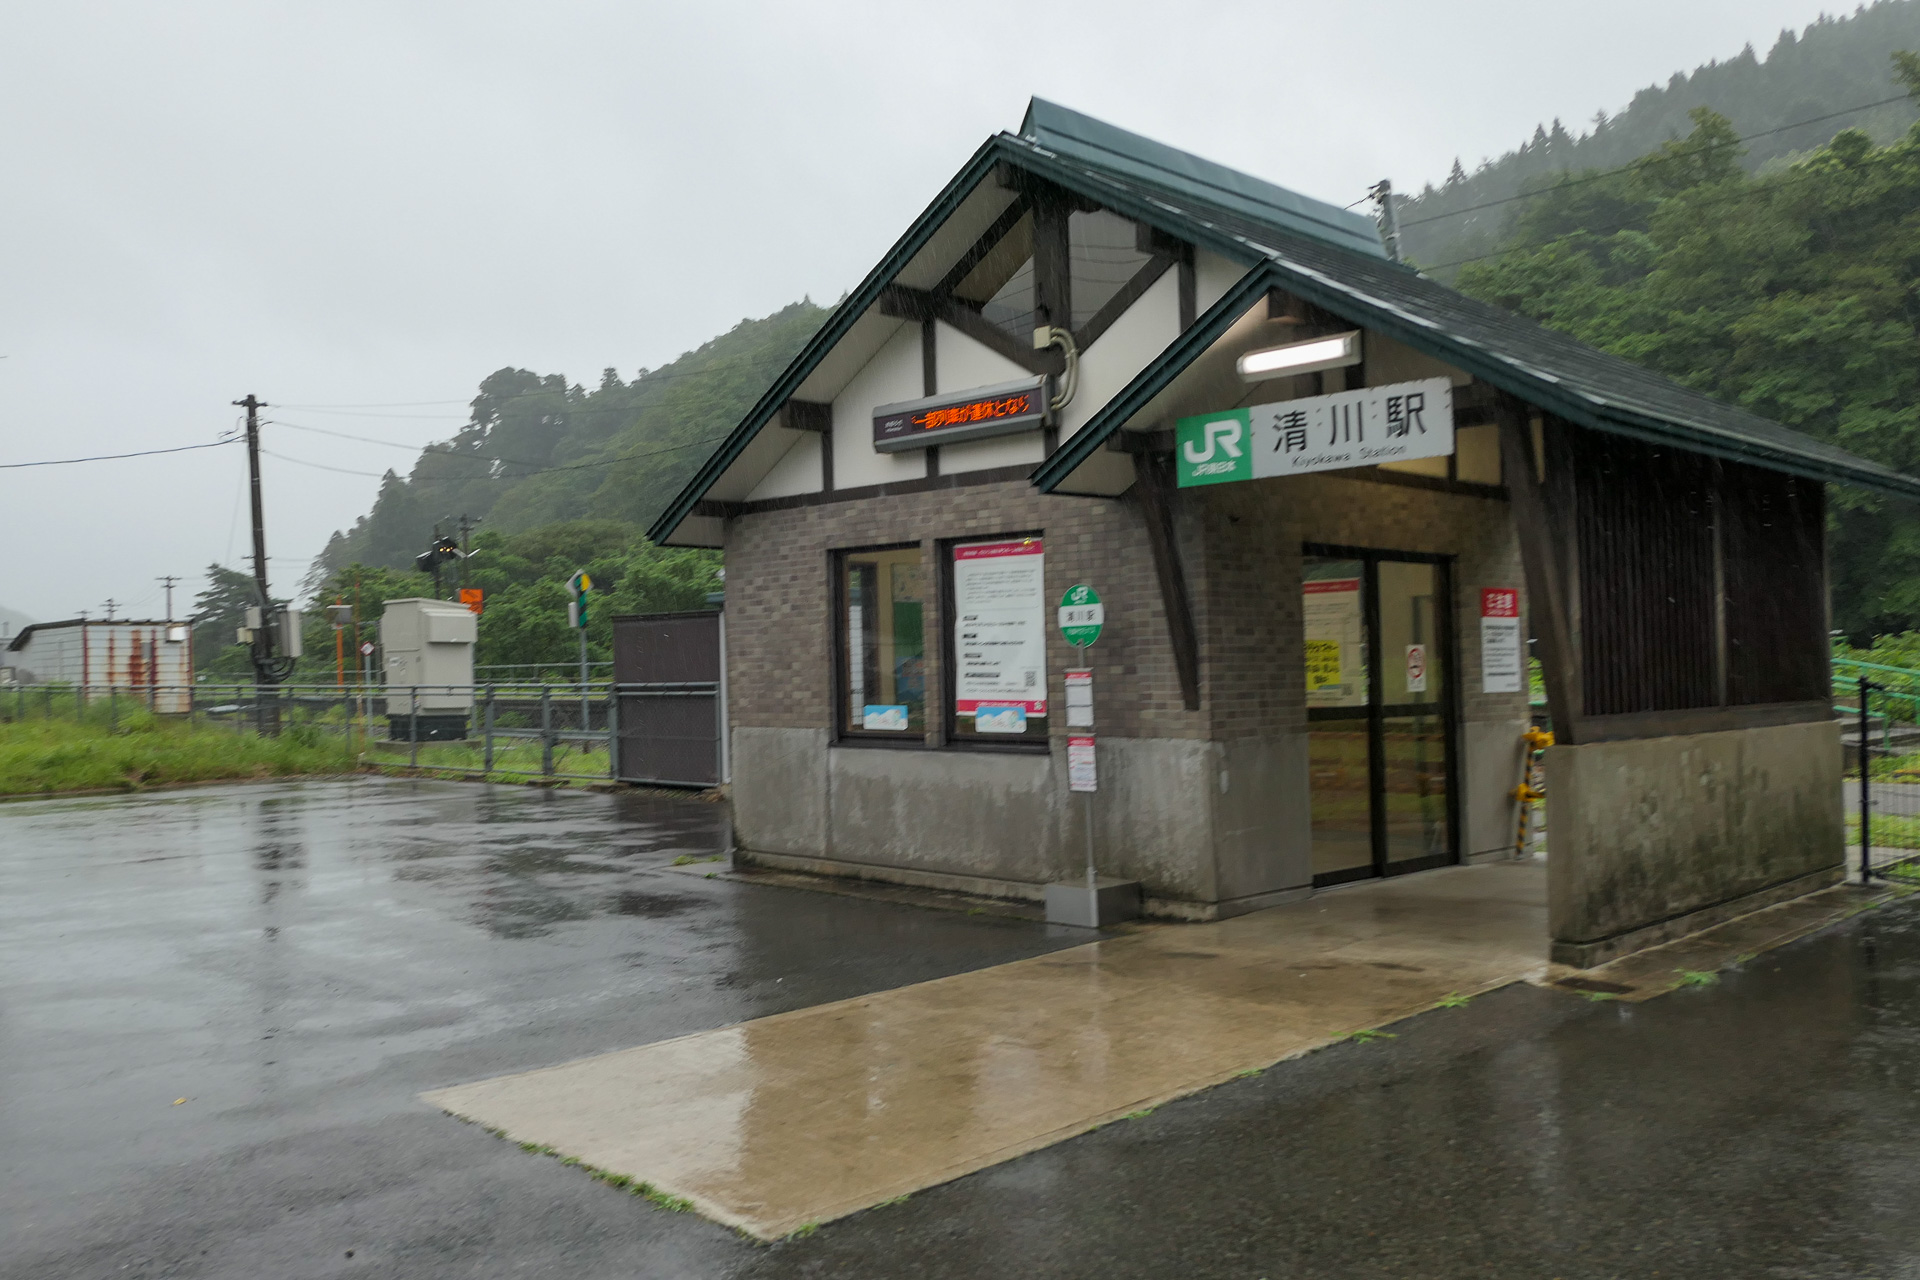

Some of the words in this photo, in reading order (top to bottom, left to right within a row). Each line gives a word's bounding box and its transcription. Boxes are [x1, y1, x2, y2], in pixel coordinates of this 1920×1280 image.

[1183, 418, 1243, 463] JR
[1272, 392, 1428, 454] 清川駅
[1291, 451, 1352, 468] Kiyokawa
[1359, 444, 1408, 460] Station
